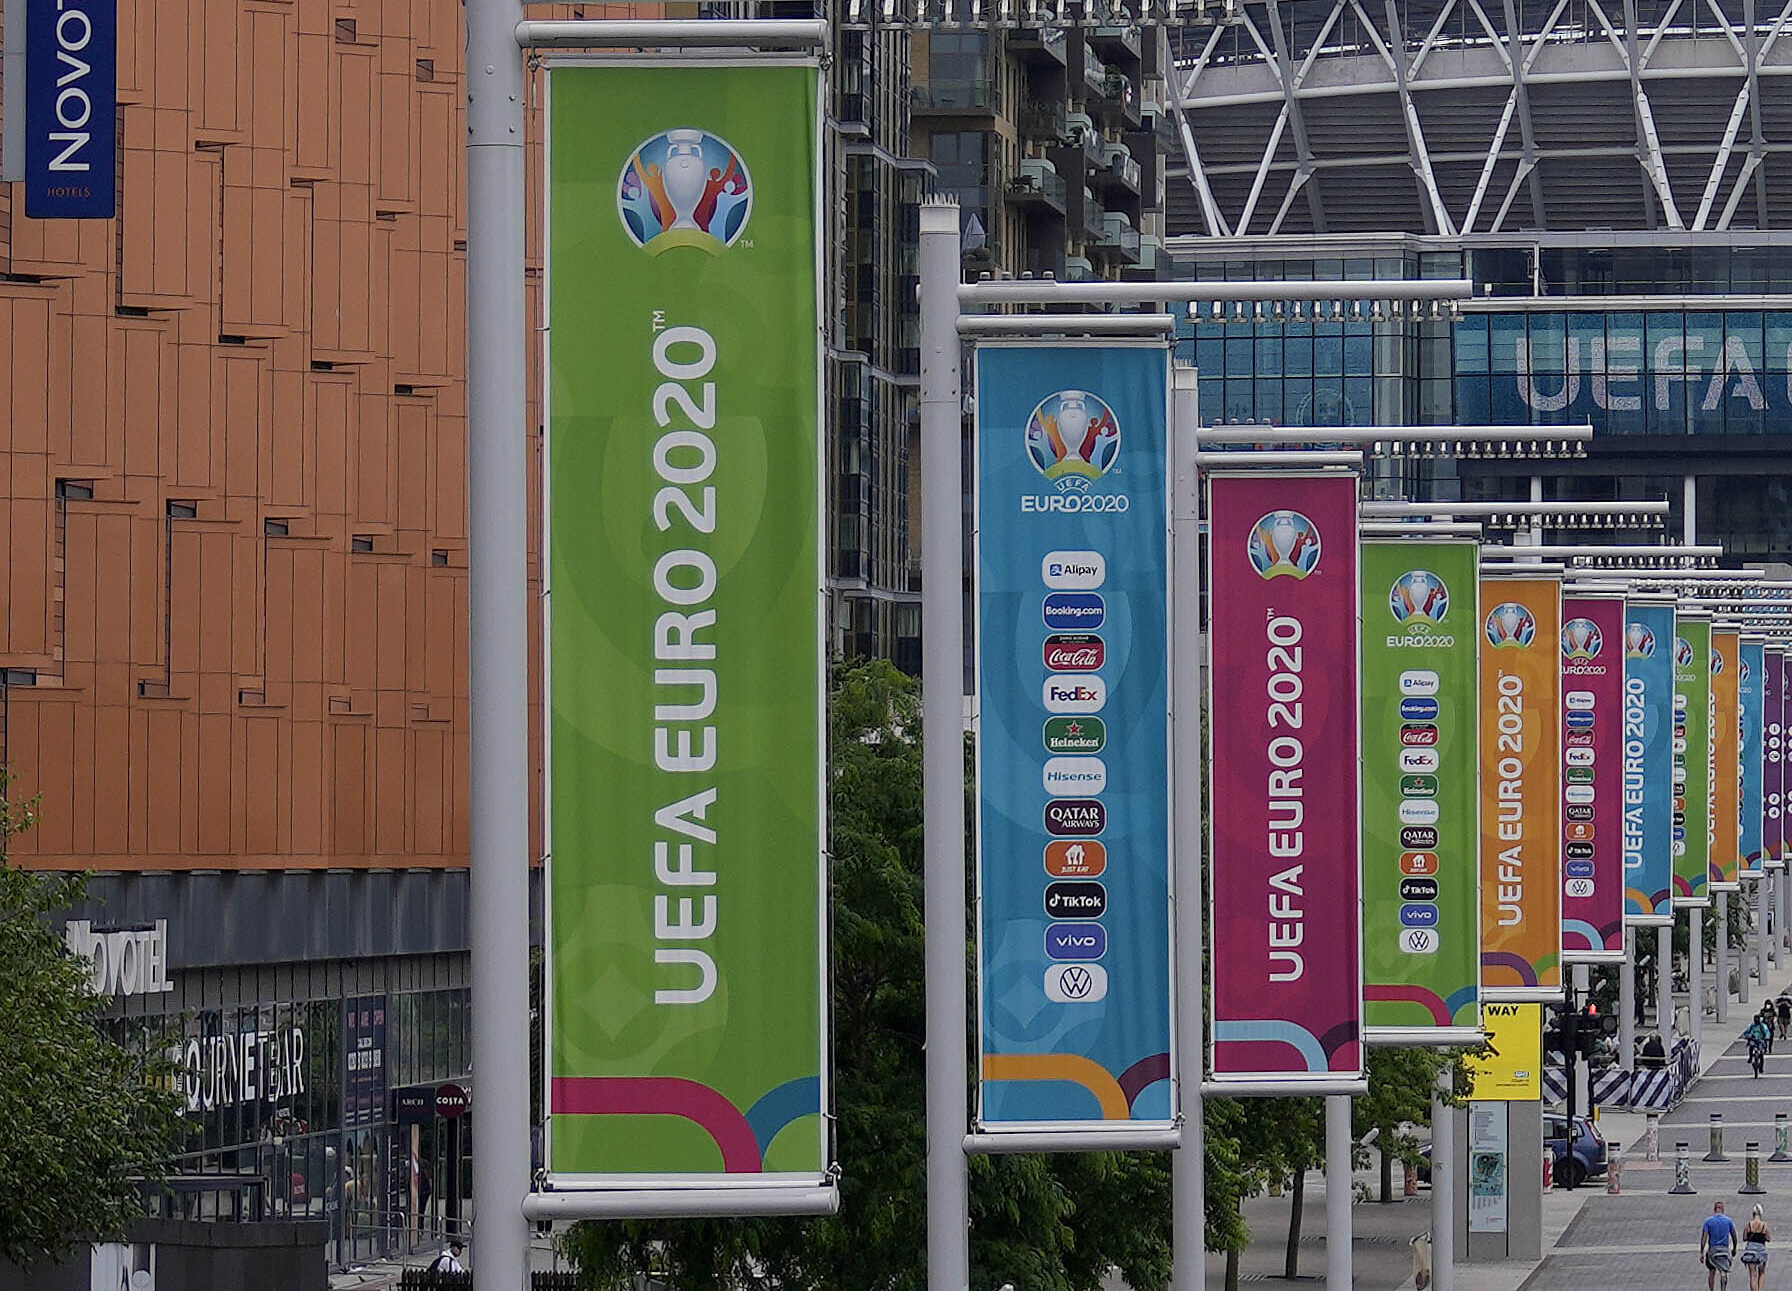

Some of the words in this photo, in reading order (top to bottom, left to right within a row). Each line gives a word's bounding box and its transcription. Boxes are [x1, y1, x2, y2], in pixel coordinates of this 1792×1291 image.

[47, 186, 91, 198] HOTELS
[1516, 335, 1765, 412] UEFA
[653, 326, 717, 533] 2020
[1056, 479, 1090, 493] UEFA
[1021, 494, 1129, 513] EURO2020
[1064, 563, 1098, 577] Alipay
[1045, 605, 1103, 618] Booking.com
[1386, 636, 1455, 647] EURO2020
[653, 550, 718, 772] EURO
[1267, 617, 1303, 729] 2020
[1562, 666, 1607, 675] URO2020
[1050, 686, 1097, 702] FedEx
[1498, 675, 1524, 752] 2020
[1626, 678, 1645, 738] 2020
[1050, 737, 1099, 748] Heineken
[1404, 755, 1433, 766] FedEx
[1047, 771, 1102, 782] Hisense
[1626, 740, 1645, 804] EURO
[1268, 736, 1304, 857] EURO
[1498, 759, 1524, 841] EURO
[1050, 807, 1099, 822] QATAR
[1062, 819, 1100, 829] AIRWAYS
[1403, 831, 1434, 841] QATAR
[1625, 807, 1644, 869] UEFA
[1498, 846, 1523, 926] UEFA
[655, 787, 719, 1005] UEFA
[1062, 895, 1102, 907] TikTok
[1407, 911, 1432, 919] vivo
[1269, 864, 1304, 982] UEFA
[1056, 934, 1096, 947] vivo
[1488, 1006, 1519, 1016] WAY
[269, 1028, 305, 1102] BAR
[401, 1098, 424, 1106] ARCH
[436, 1096, 464, 1106] COSTA
